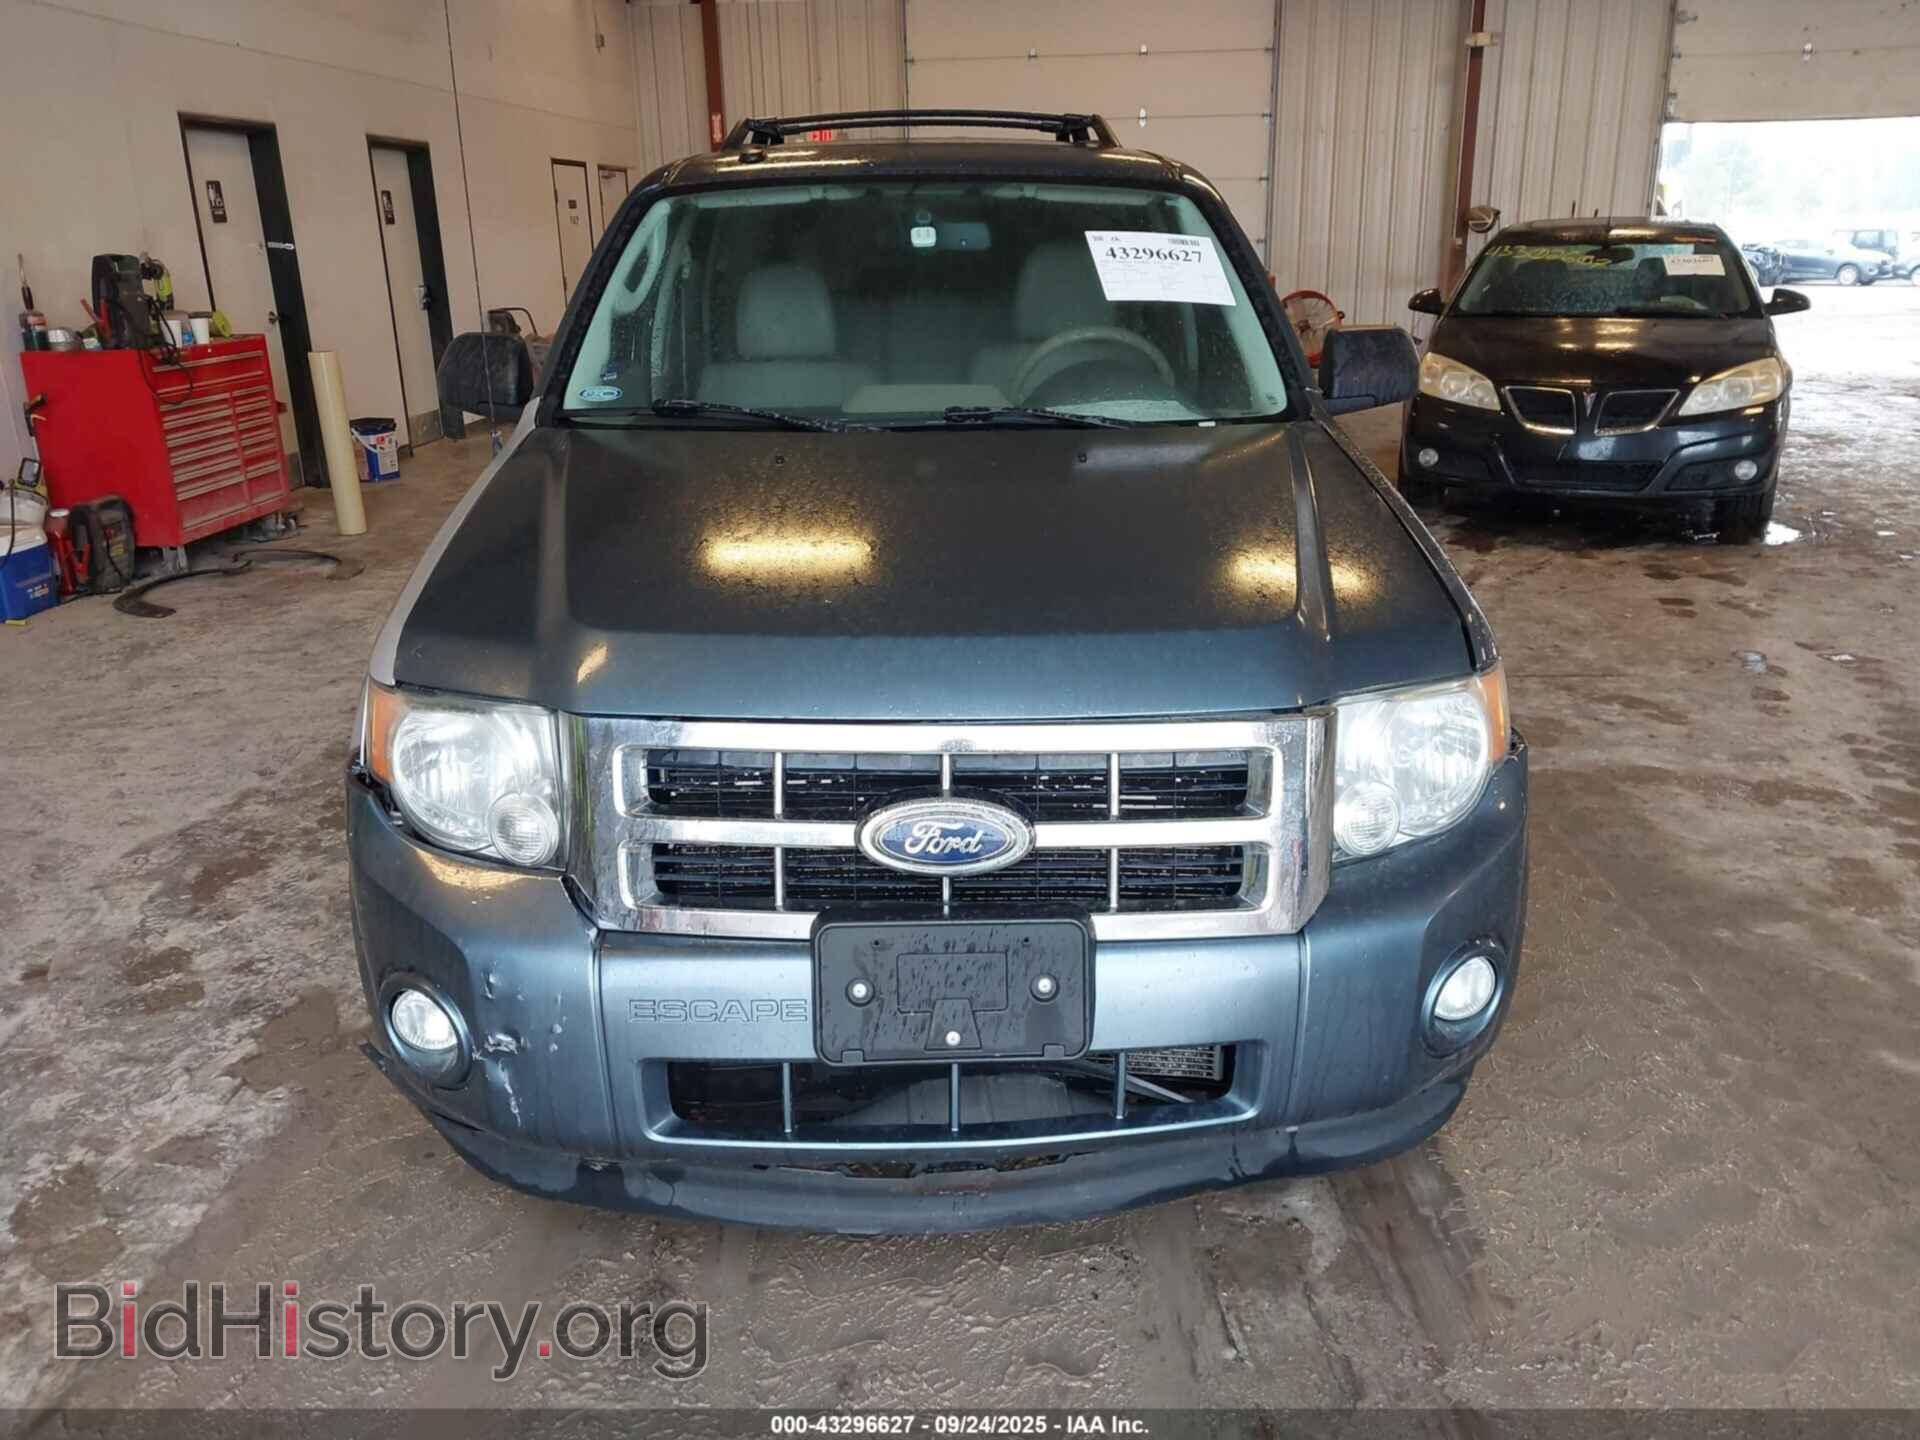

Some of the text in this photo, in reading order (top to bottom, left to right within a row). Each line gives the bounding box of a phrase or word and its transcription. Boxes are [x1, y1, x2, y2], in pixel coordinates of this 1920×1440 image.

[1105, 246, 1202, 263] 43296627
[904, 820, 984, 854] Ford
[628, 999, 808, 1023] ESCAPE
